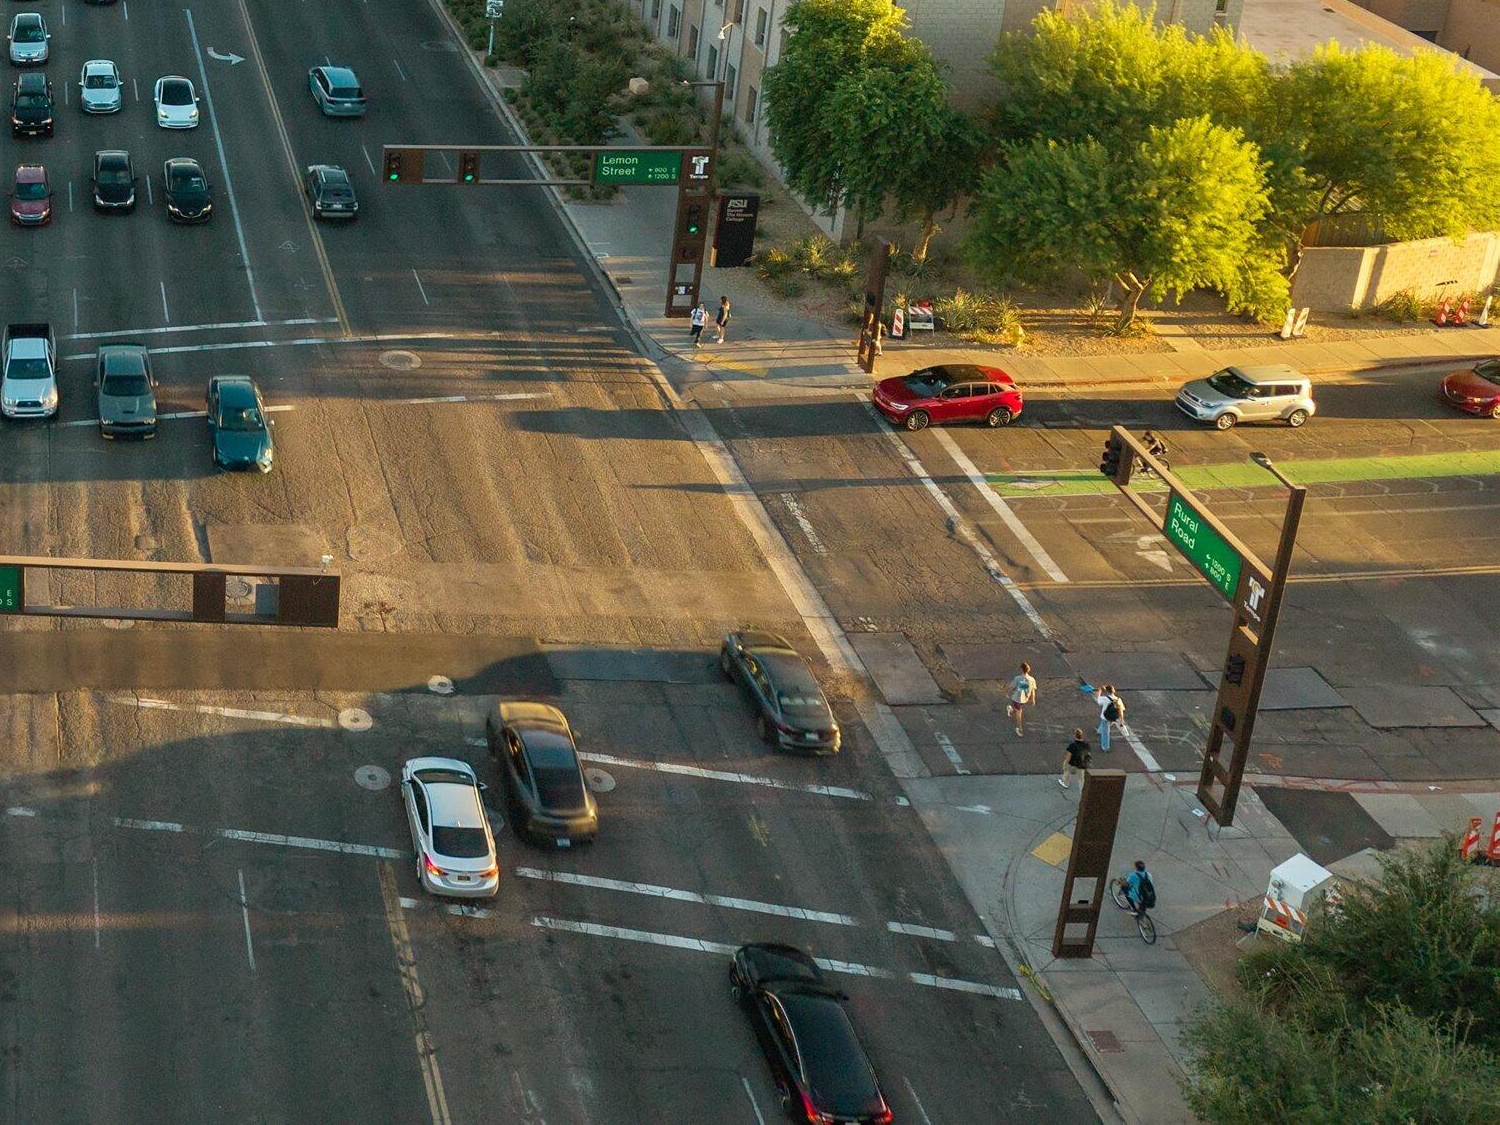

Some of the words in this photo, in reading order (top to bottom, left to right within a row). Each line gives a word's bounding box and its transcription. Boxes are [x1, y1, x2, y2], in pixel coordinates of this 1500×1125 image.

[602, 156, 638, 165] Lemon
[602, 167, 636, 175] Street
[1174, 502, 1199, 534] Rural
[1171, 518, 1196, 550] Road
[7, 589, 12, 597] E
